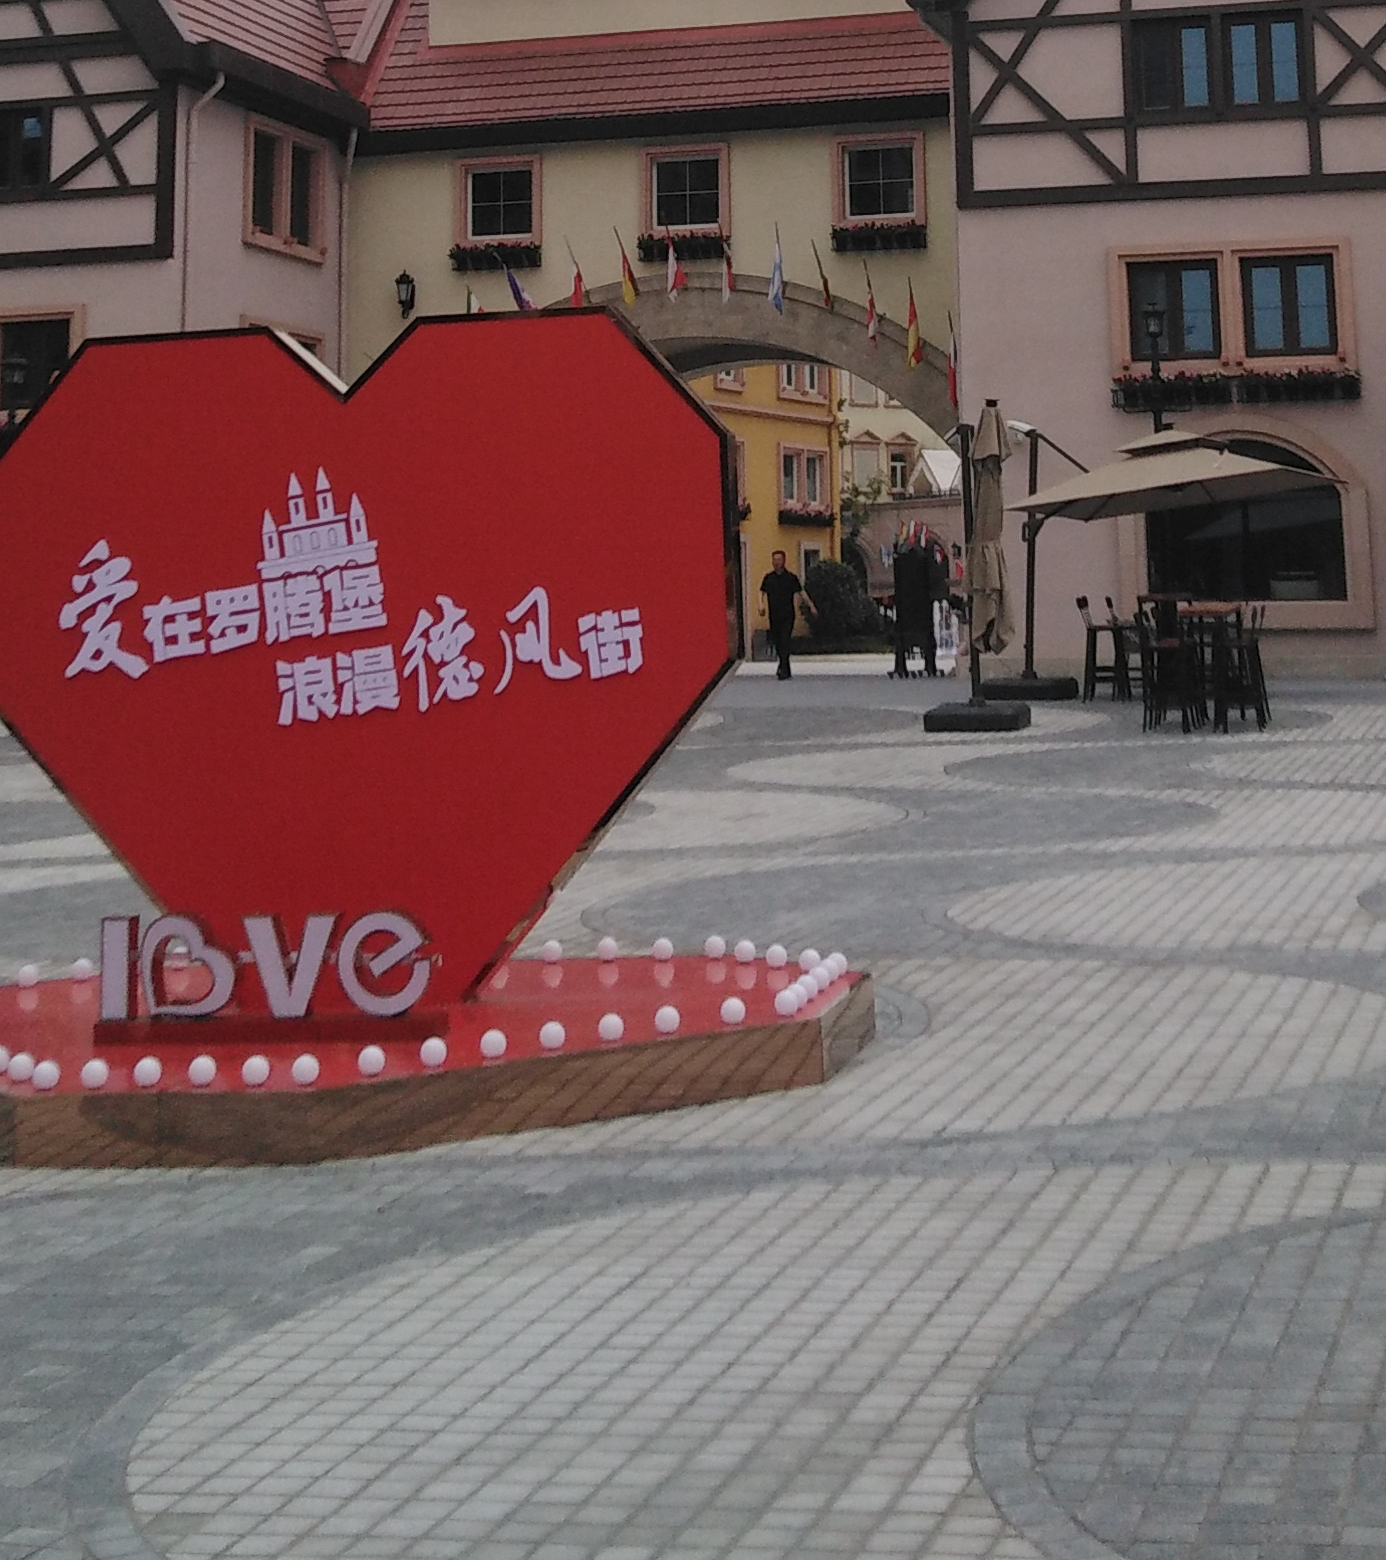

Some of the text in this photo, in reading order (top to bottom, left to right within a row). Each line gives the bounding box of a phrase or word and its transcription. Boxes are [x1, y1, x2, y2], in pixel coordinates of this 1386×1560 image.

[59, 539, 388, 680] 爱在罗腾堡
[275, 586, 643, 727] 浪漫德风街
